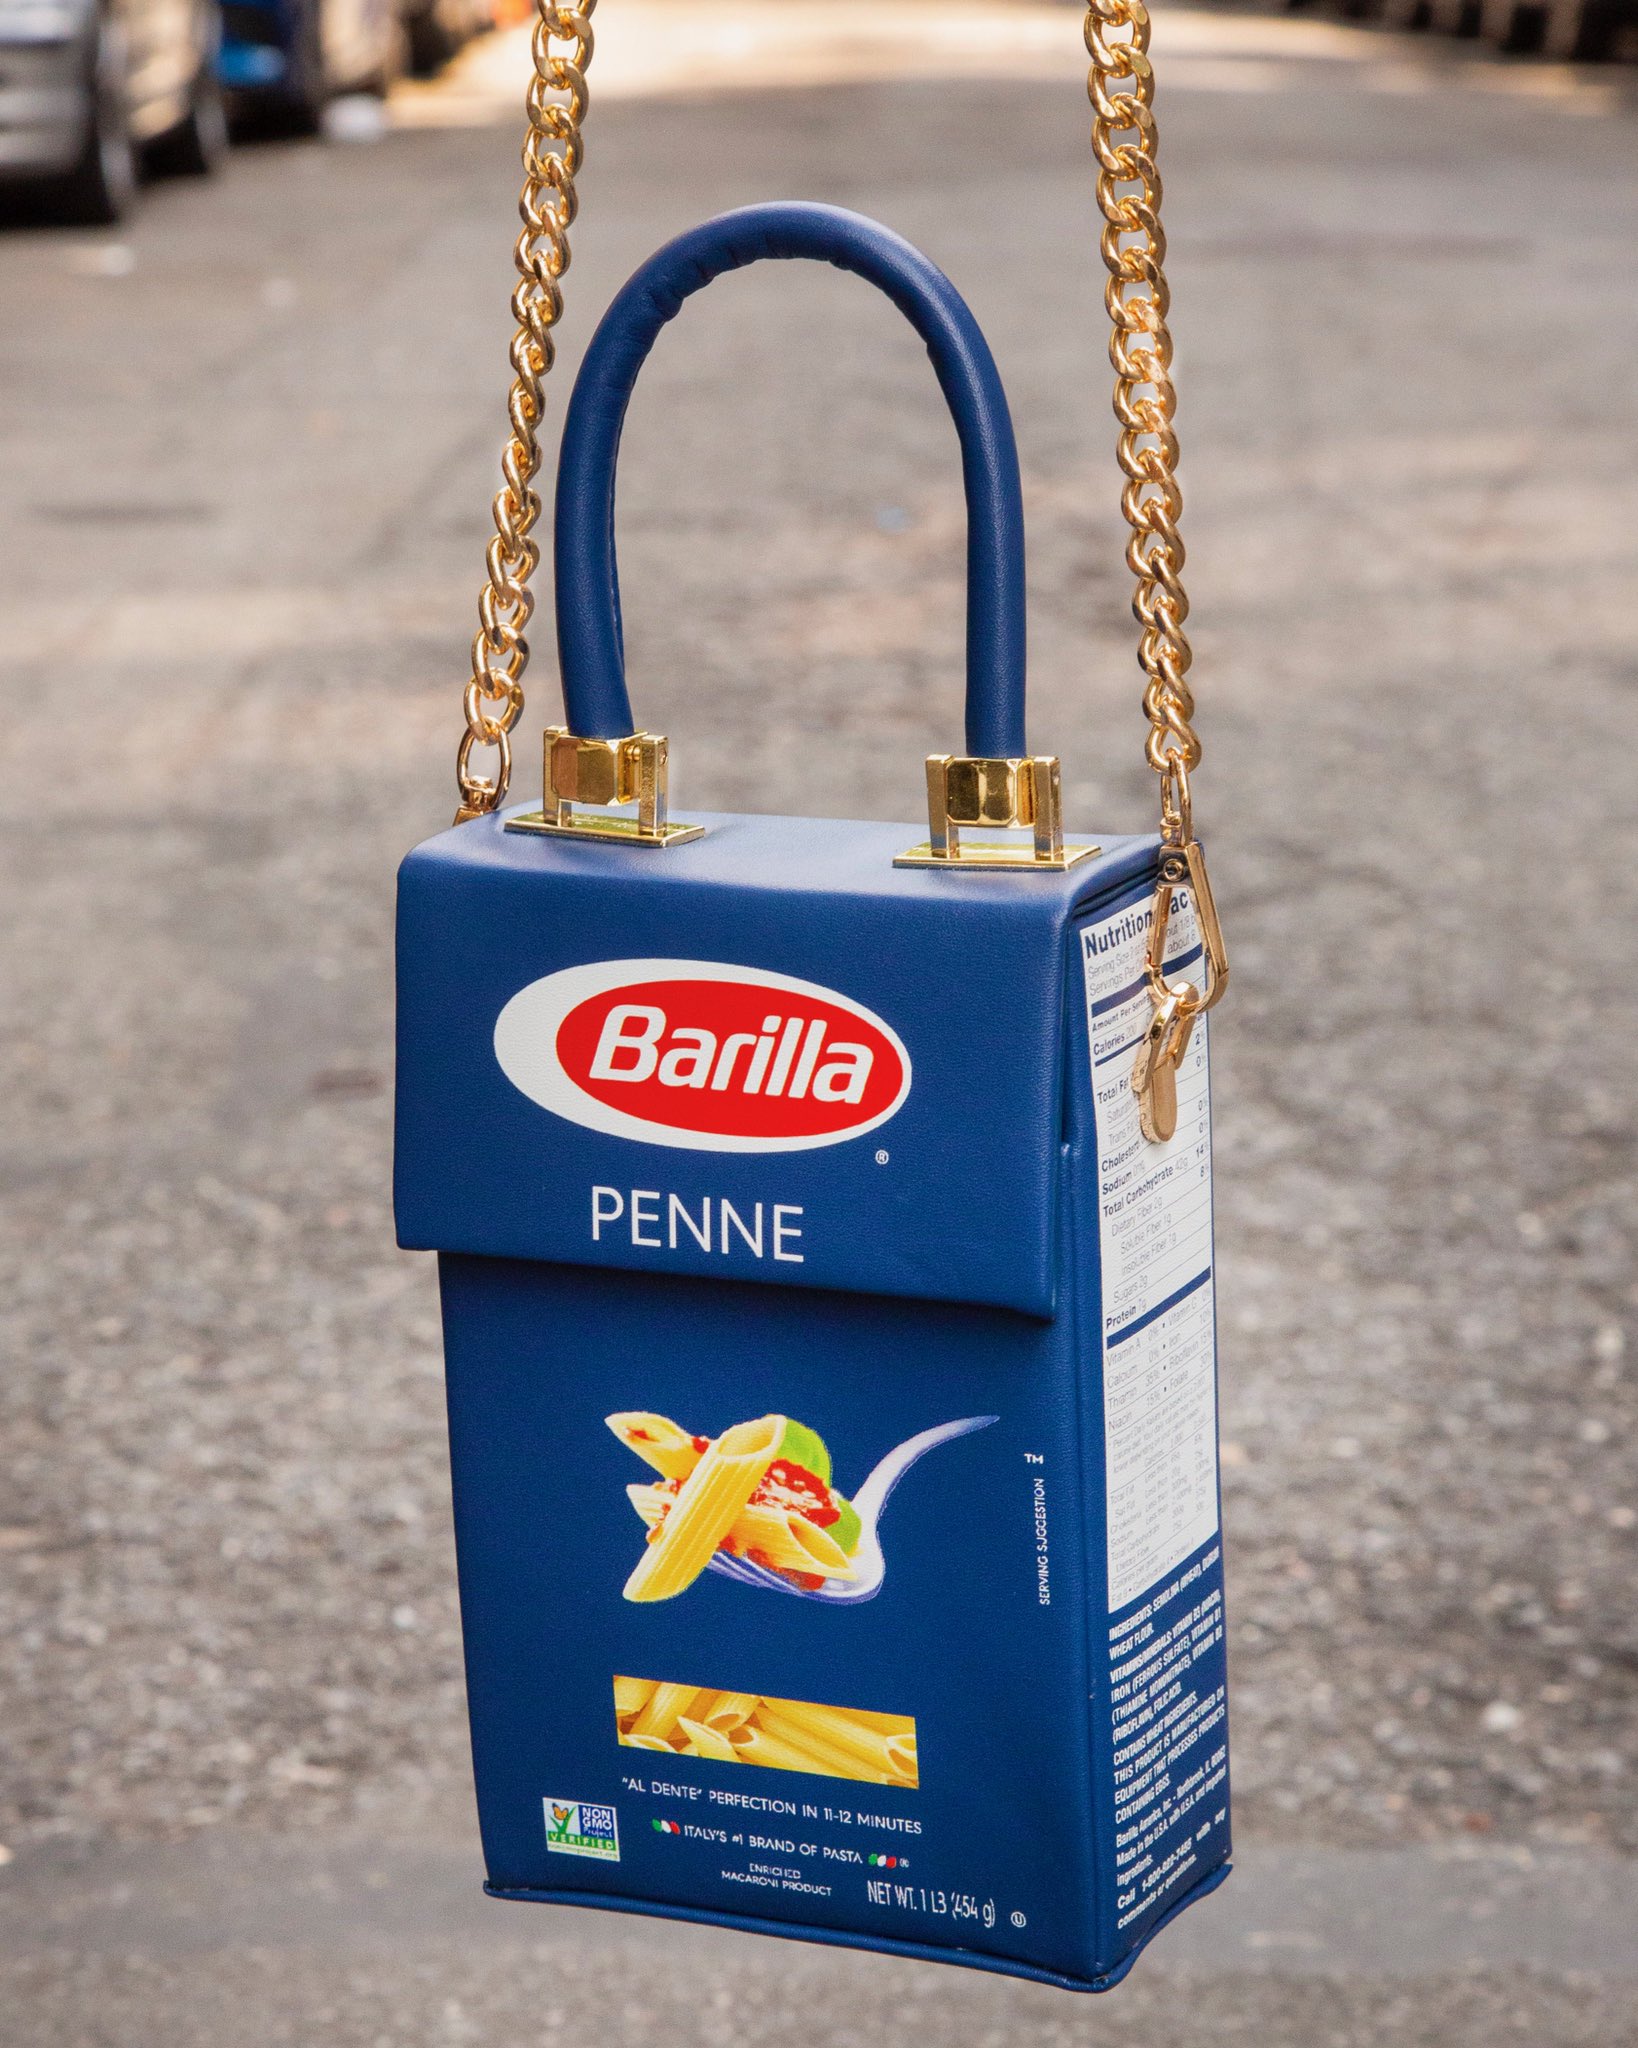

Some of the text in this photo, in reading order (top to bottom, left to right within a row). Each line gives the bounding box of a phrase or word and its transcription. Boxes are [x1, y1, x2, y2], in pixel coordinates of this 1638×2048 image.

[1085, 909, 1153, 957] Nutrition
[1091, 1012, 1118, 1032] Amount
[1120, 1006, 1131, 1018] Per
[589, 1004, 874, 1104] Barilla
[1092, 1033, 1124, 1055] Calories
[1096, 1076, 1128, 1104] Total Fat
[1101, 1140, 1139, 1172] Cholesterol
[1101, 1171, 1131, 1195] Sodium
[1103, 1196, 1124, 1217] Total
[1125, 1166, 1173, 1204] Carbohydrate
[592, 1185, 804, 1263] PENNE
[1111, 1195, 1162, 1237] Dietary Fiber 2g
[1120, 1231, 1144, 1255] Soluble
[1145, 1219, 1161, 1236] Fiber
[1121, 1250, 1150, 1276] Insoluble
[1150, 1238, 1167, 1256] Fiber
[1113, 1281, 1138, 1304] Sugars
[1105, 1305, 1136, 1329] Protein
[1105, 1344, 1134, 1366] Vitamin
[1135, 1336, 1141, 1350] A
[1106, 1364, 1137, 1389] Calcium
[1169, 1369, 1188, 1390] Folate
[1108, 1411, 1132, 1431] Niacin
[1037, 1555, 1051, 1606] SERVING
[1108, 1604, 1152, 1640] INGREDIENTS:
[1152, 1581, 1179, 1611] SEMOLINA
[1108, 1635, 1133, 1660] WHEAT
[1110, 1682, 1130, 1702] IRON
[1131, 1657, 1162, 1692] (FERROUS
[1191, 1613, 1214, 1640] VITAMIN
[1111, 1689, 1147, 1724] (THIAMINE
[1192, 1632, 1214, 1659] VITAMIN
[1113, 1685, 1224, 1784] THIS PRODUCT IS MANUFACTURED ON
[1113, 1734, 1146, 1765] CONTAINS
[1145, 1718, 1164, 1743] WHEAT
[1114, 1703, 1224, 1804] EQUIPMENT THAT PROCESSES PRODUCTS
[582, 1806, 611, 1820] NON
[709, 1790, 796, 1816] PERFECTION
[802, 1804, 818, 1819] IN
[823, 1807, 852, 1824] 11-12
[857, 1812, 922, 1834] MINUTES
[1115, 1786, 1154, 1823] CONTAINING
[1116, 1847, 1136, 1866] Made
[1136, 1841, 1143, 1854] in
[1143, 1832, 1153, 1848] the
[1168, 1807, 1180, 1825] with
[1195, 1783, 1205, 1801] and
[1205, 1764, 1226, 1792] imported
[550, 1832, 614, 1850] VERIFIED
[582, 1816, 612, 1831] GMO
[1115, 1825, 1138, 1847] Barilla
[684, 1825, 863, 1864] ITALY'S #1 BRAND OF PASTA
[721, 1870, 832, 1896] MACARONI PRODUCT
[1117, 1887, 1135, 1909] Call
[1195, 1821, 1210, 1841] with
[867, 1880, 891, 1906] NET
[895, 1885, 918, 1910] WT.
[920, 1889, 927, 1912] 1
[949, 1890, 979, 1920] (454
[982, 1898, 996, 1928] g)
[1117, 1891, 1156, 1928] comments
[1156, 1882, 1165, 1896] or
